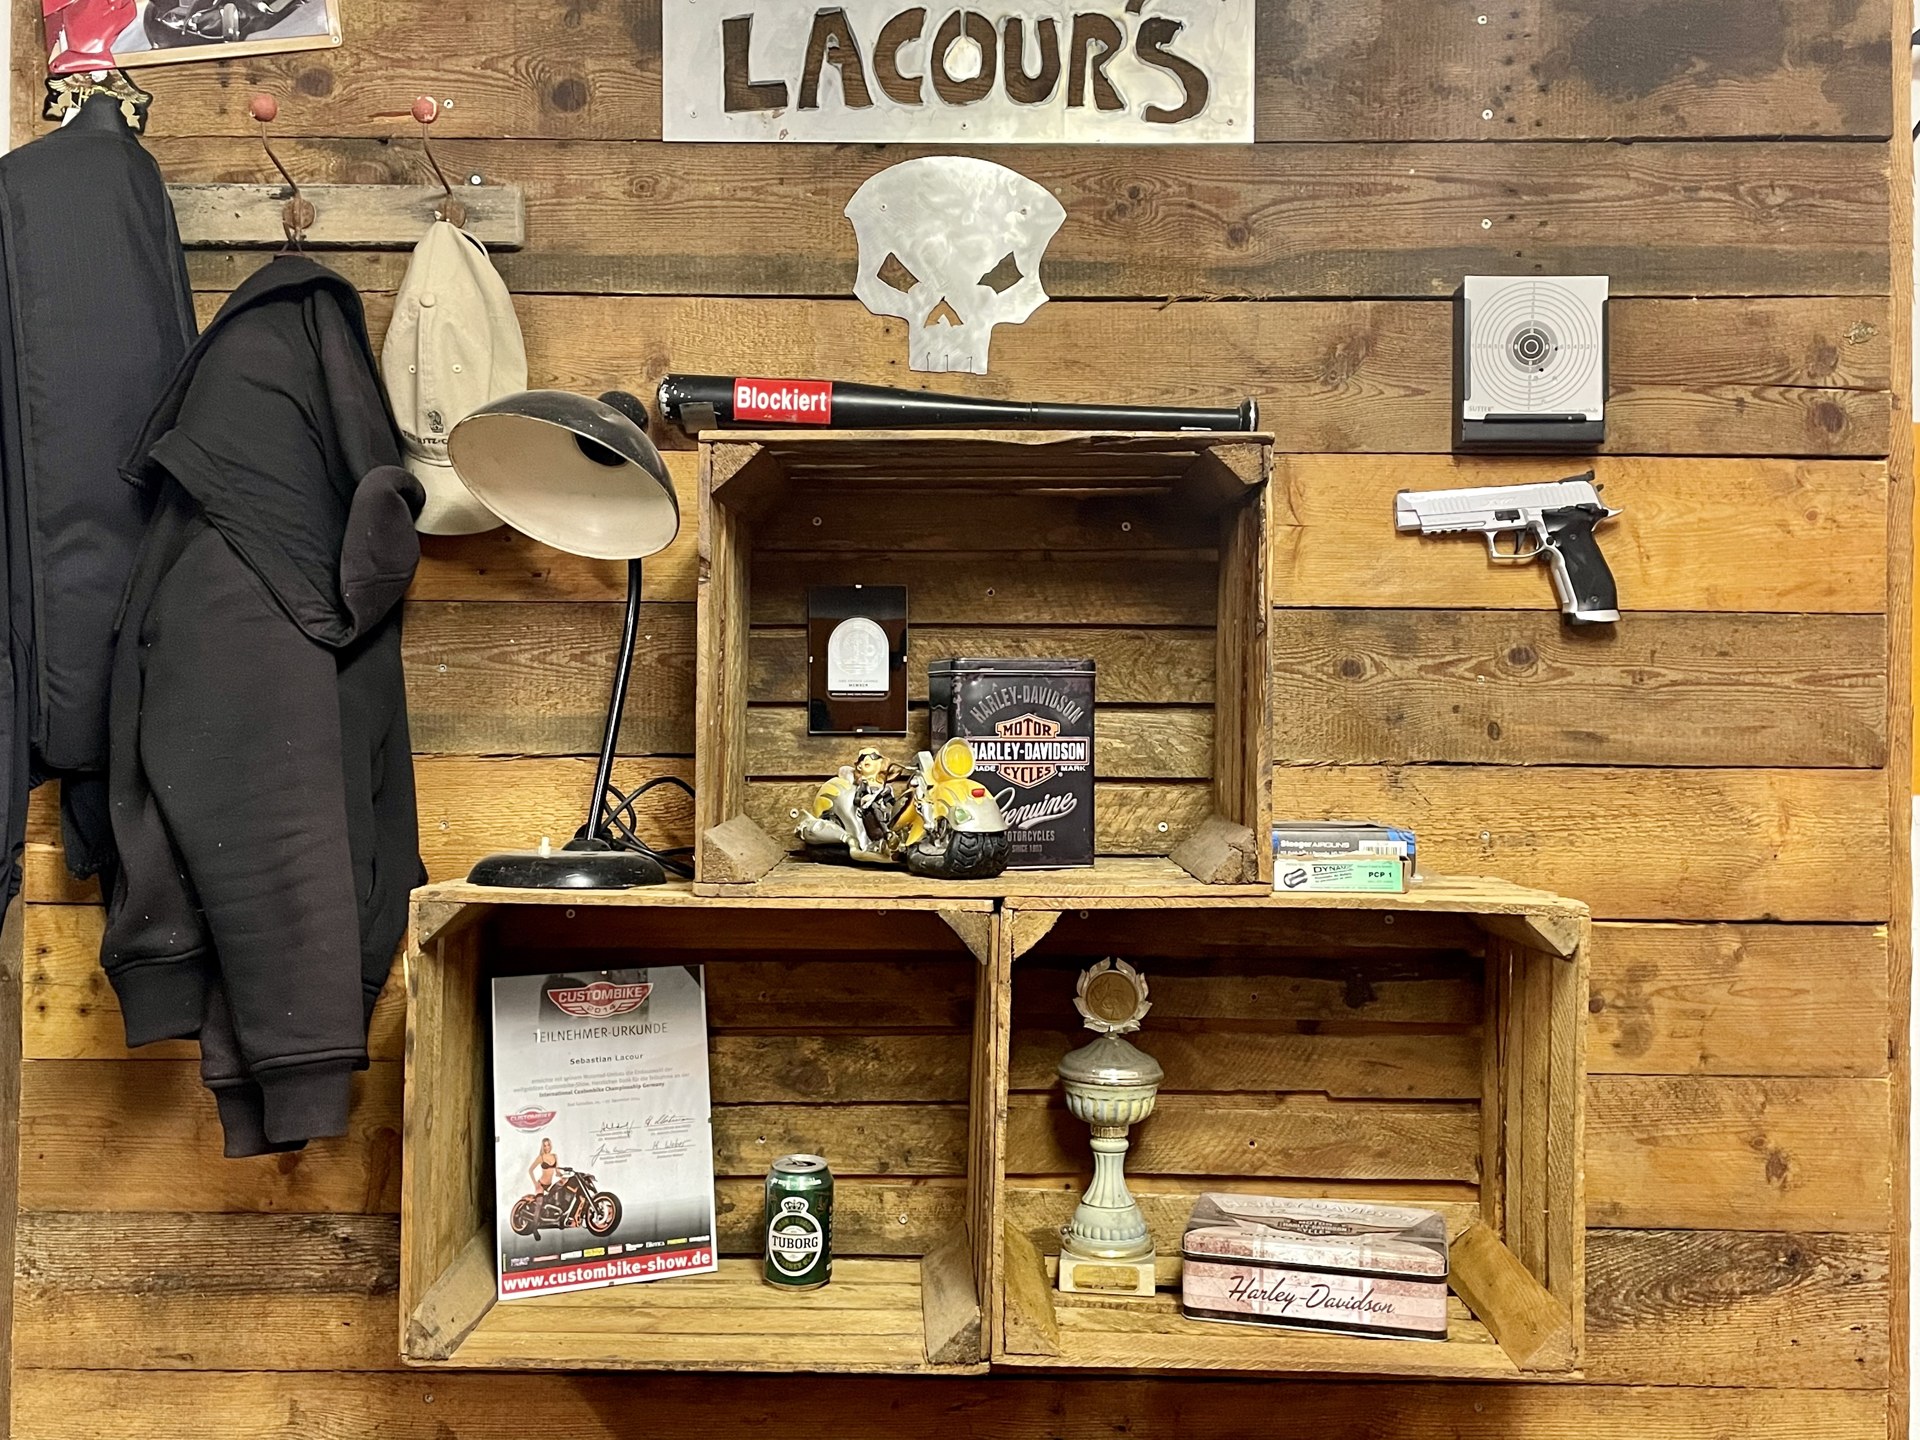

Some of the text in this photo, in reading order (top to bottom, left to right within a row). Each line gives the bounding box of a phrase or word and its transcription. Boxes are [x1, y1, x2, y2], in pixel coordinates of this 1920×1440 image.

[737, 385, 827, 412] Blockiert
[969, 684, 1085, 725] HARLEY-DAVIDSON
[1002, 718, 1052, 737] MOTOR
[973, 742, 1085, 761] HARLEY-DAVIDSON
[1003, 766, 1051, 784] CYCLES
[558, 987, 643, 1003] CUSTOMBIKE
[533, 1022, 668, 1043] TEILNEHMER-URKUNDE
[569, 1056, 612, 1065] Sebastian
[772, 1235, 818, 1249] TUBORG
[503, 1251, 711, 1291] www.custombike-show.de
[1228, 1274, 1395, 1314] Harley-Davidson
